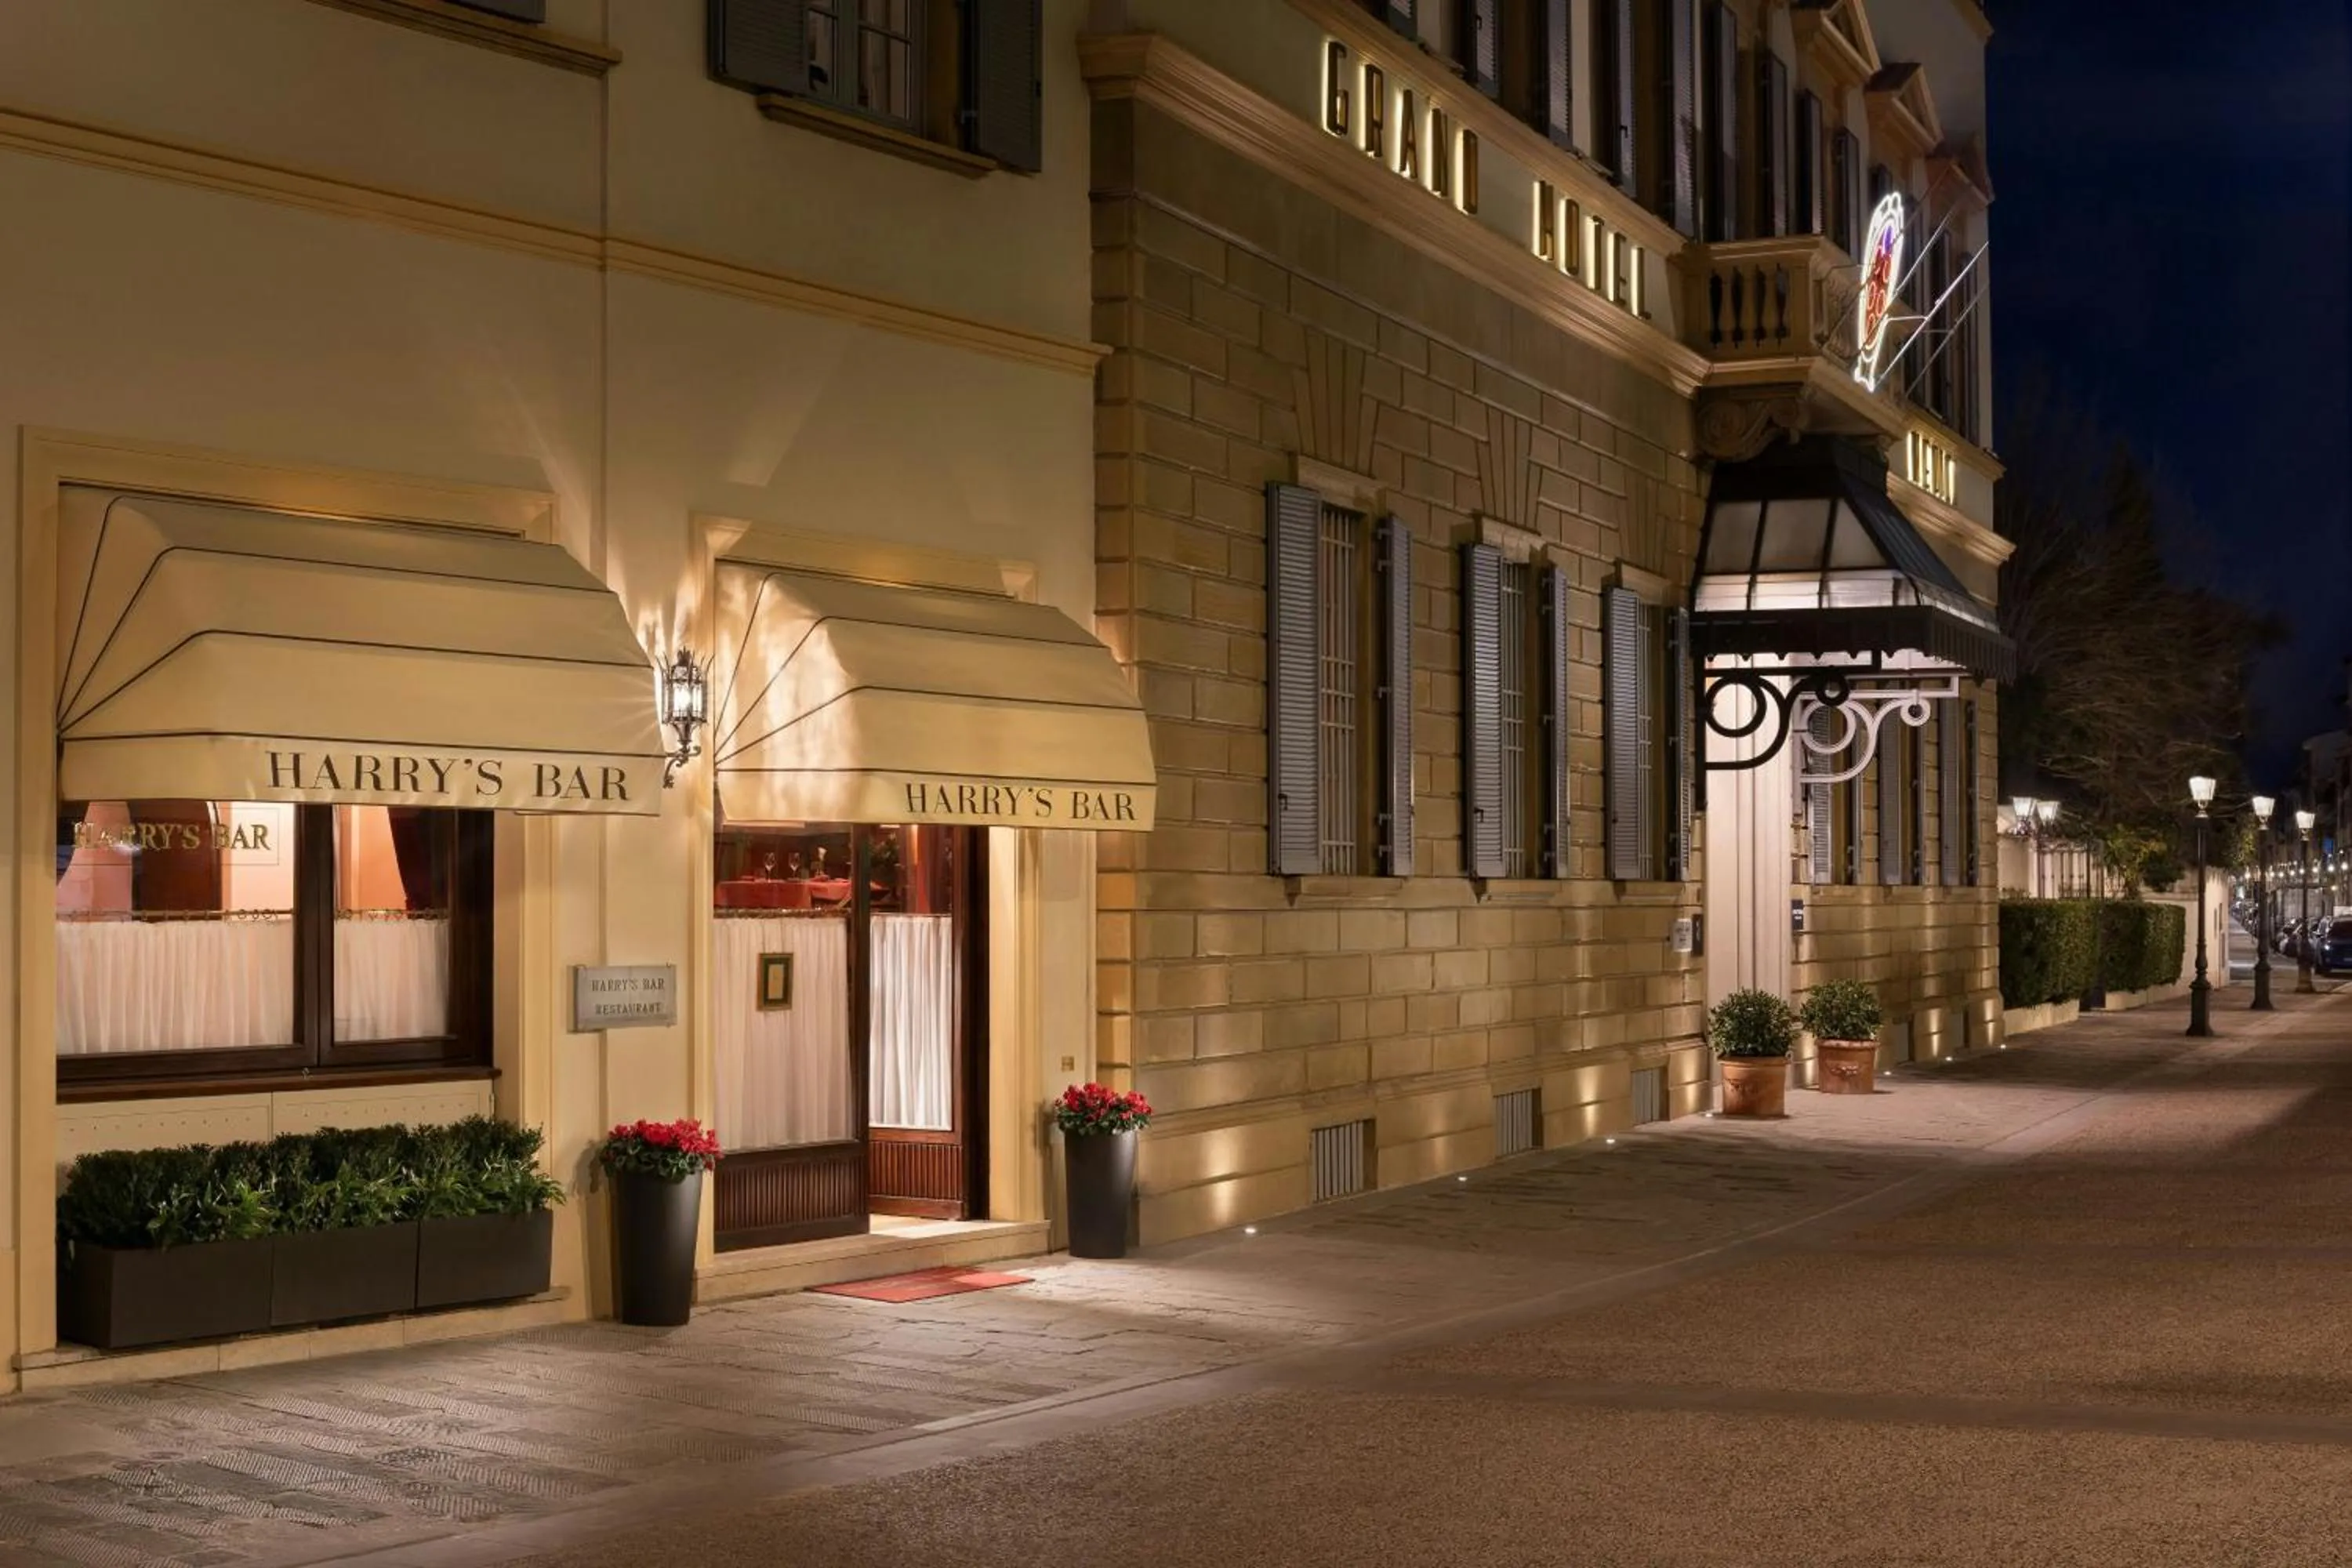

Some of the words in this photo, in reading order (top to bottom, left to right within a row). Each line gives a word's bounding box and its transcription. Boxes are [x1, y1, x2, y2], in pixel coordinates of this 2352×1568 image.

[1323, 36, 1479, 215] GRAND
[1533, 179, 1652, 320] HOTEL
[265, 750, 503, 797] HARRY'S
[531, 762, 630, 802] BAR
[905, 782, 1053, 818] HARRY'S
[1070, 790, 1136, 822] BAR
[212, 823, 270, 851] BAR
[642, 978, 665, 990] BAR
